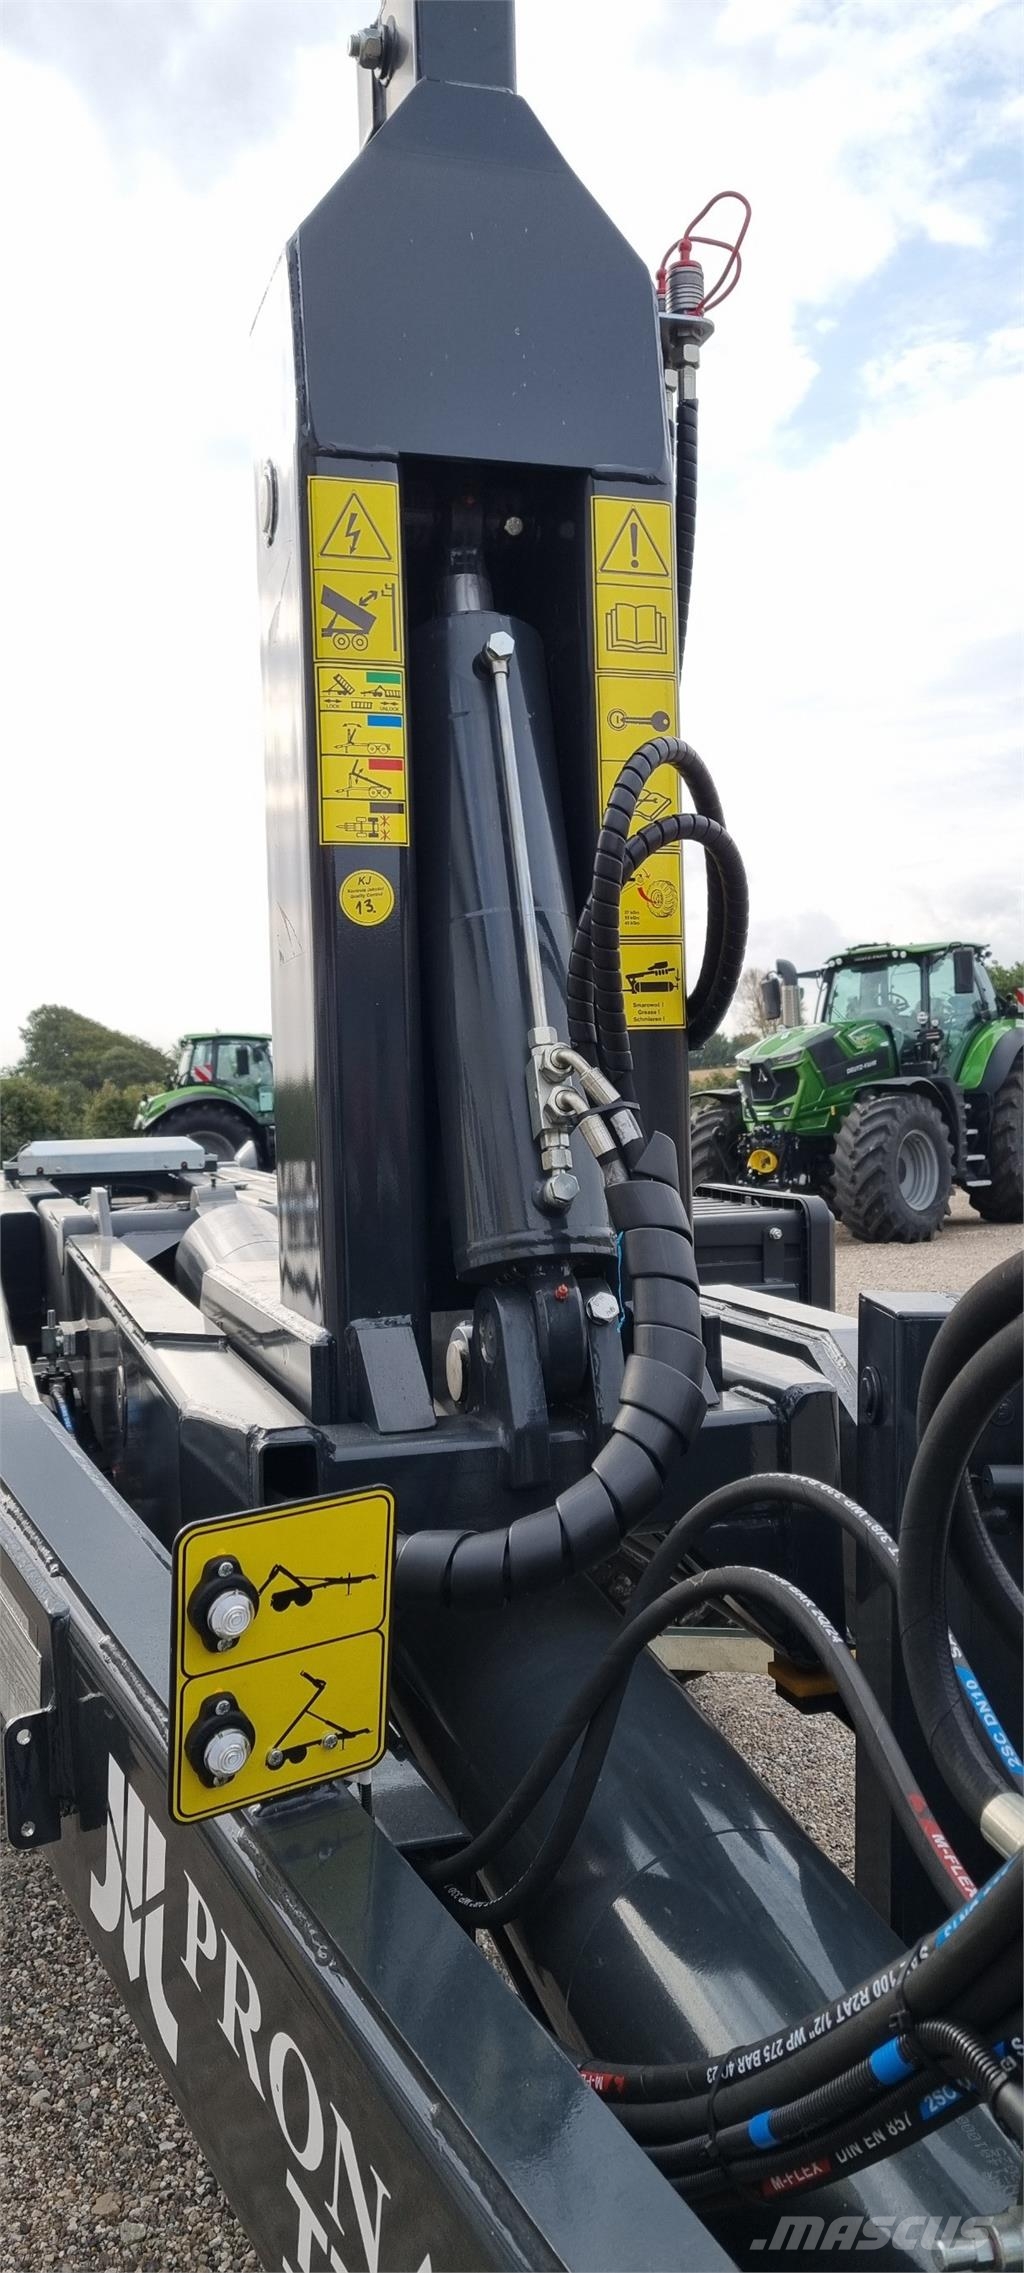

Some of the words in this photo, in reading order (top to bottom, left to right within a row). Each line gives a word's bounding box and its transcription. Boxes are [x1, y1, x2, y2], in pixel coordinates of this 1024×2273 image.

[358, 876, 372, 886] KJ
[966, 1680, 998, 1727] DN10
[993, 1732, 1024, 1768] 2SC
[931, 1834, 978, 1898] M-FLEX
[872, 1969, 897, 1998] 100
[836, 1986, 871, 2024] R2AT
[786, 2026, 807, 2051] WP
[809, 2010, 833, 2039] 1/2"
[738, 2049, 762, 2075] BAR
[763, 2038, 783, 2063] 275
[180, 1870, 434, 2273] PRON
[922, 2082, 957, 2113] 2SC
